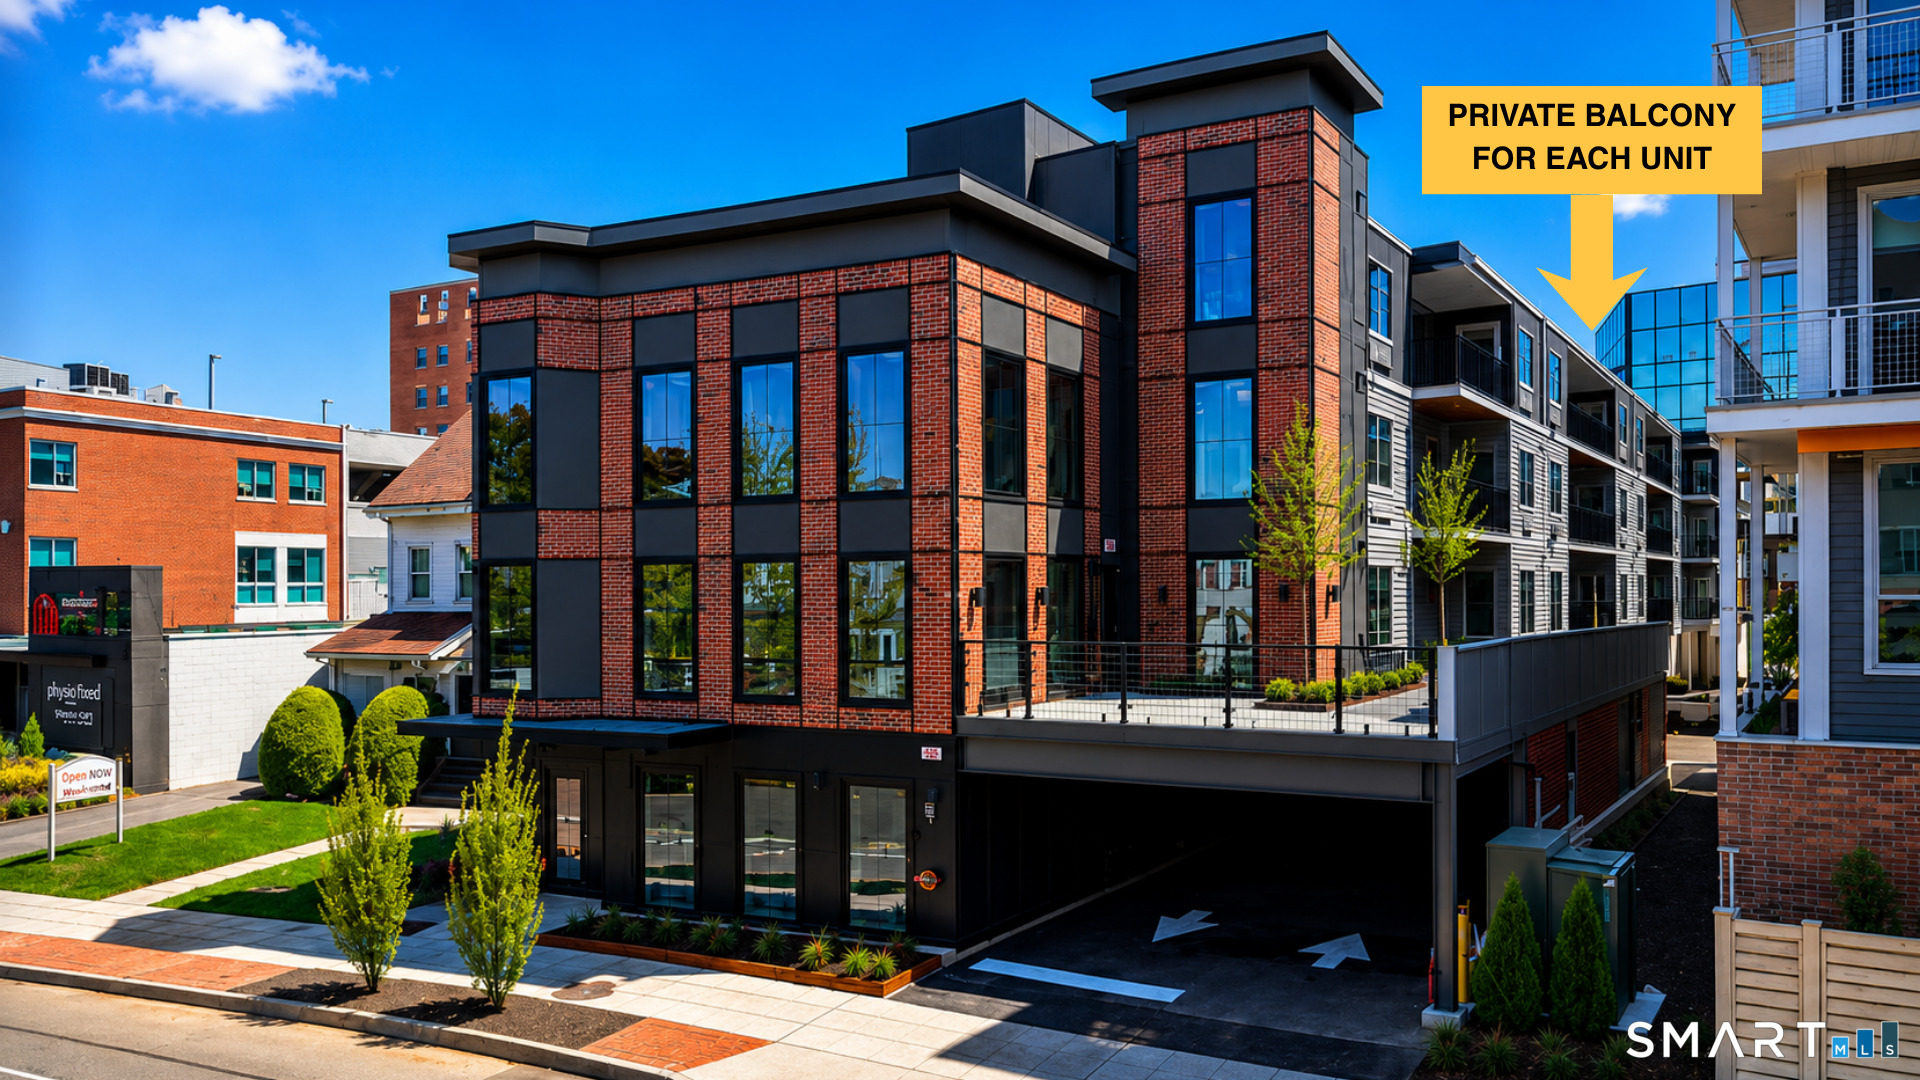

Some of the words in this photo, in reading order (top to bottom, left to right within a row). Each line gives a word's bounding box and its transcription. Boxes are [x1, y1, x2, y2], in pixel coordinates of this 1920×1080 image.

[47, 681, 76, 701] physio
[62, 772, 87, 784] Open
[89, 768, 112, 779] NOW
